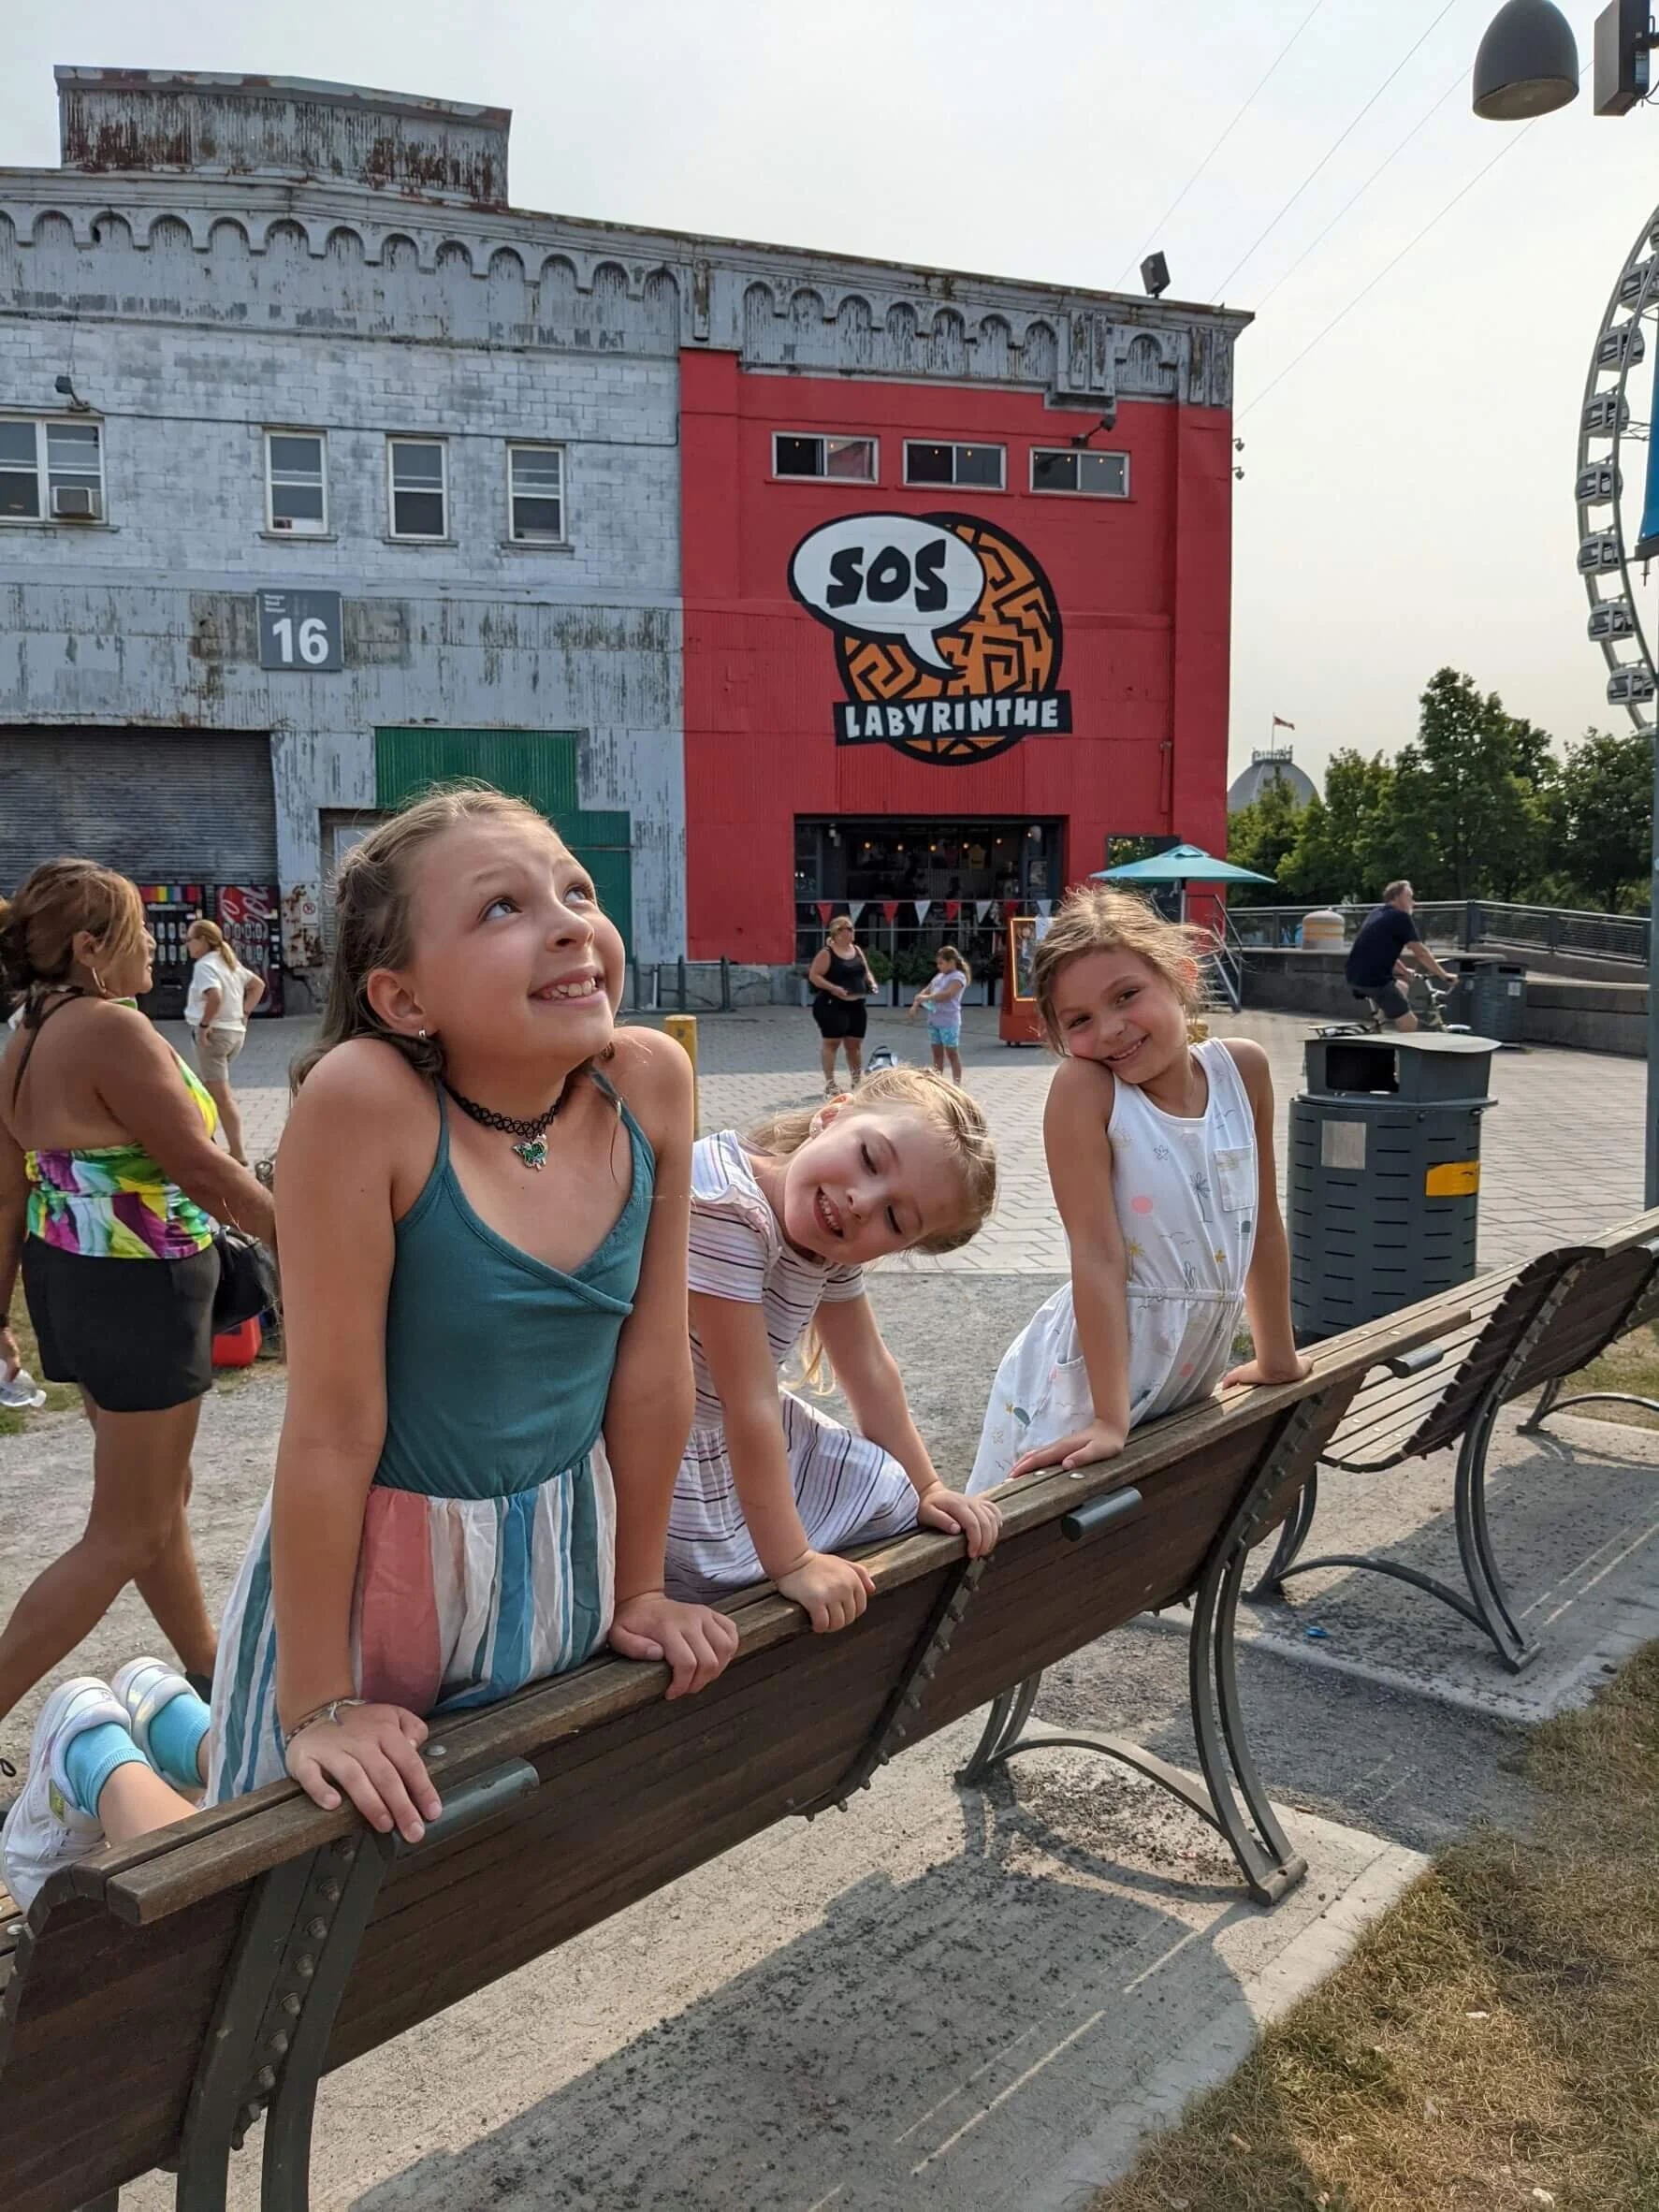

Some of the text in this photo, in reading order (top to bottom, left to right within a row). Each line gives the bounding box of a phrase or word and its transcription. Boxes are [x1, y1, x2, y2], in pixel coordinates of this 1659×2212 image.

[826, 539, 948, 612] SOS
[272, 618, 328, 664] 16
[845, 697, 1058, 738] LABYRINTHE
